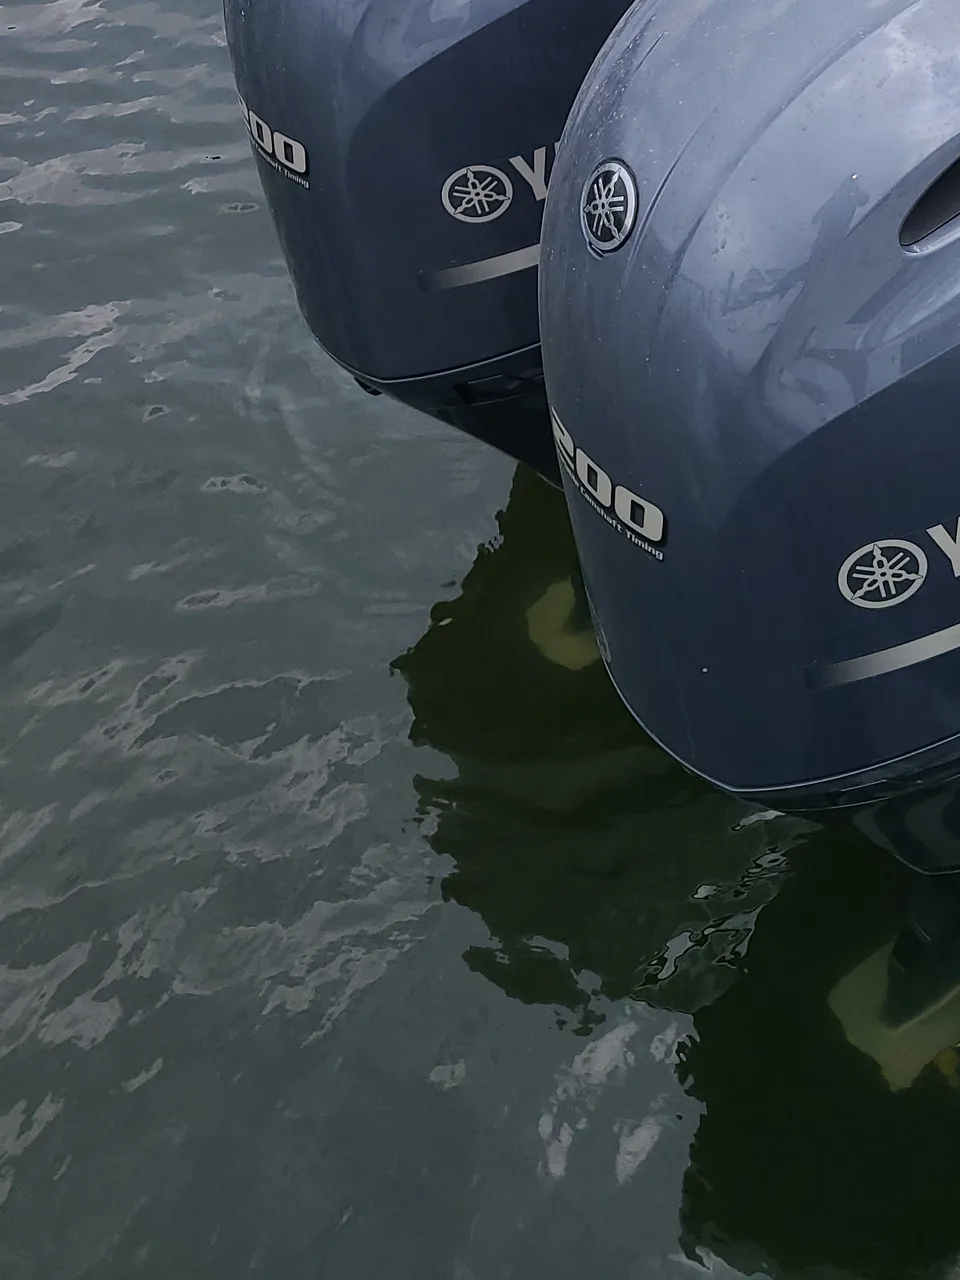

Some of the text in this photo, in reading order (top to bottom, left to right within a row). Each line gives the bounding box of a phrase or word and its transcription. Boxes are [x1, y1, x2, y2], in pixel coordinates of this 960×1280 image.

[508, 140, 561, 201] Y
[551, 403, 664, 542] 200
[624, 530, 664, 561] Timing
